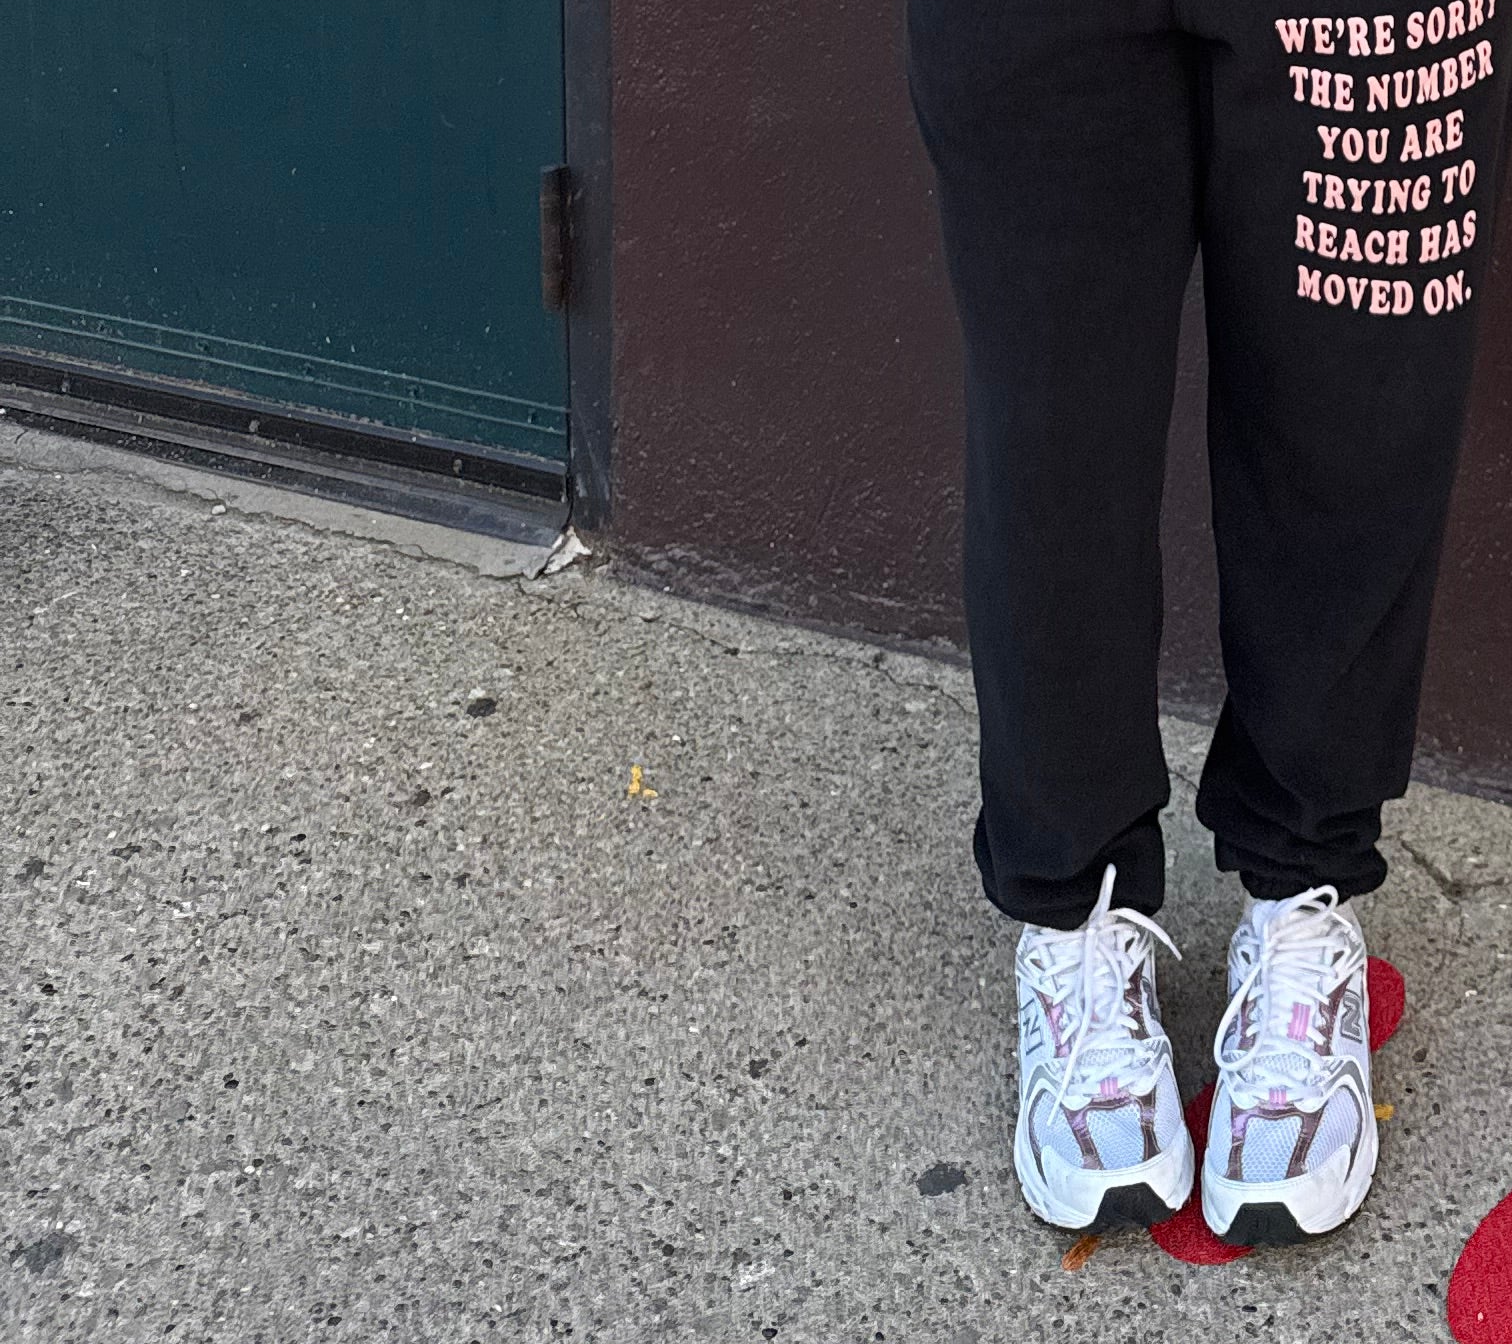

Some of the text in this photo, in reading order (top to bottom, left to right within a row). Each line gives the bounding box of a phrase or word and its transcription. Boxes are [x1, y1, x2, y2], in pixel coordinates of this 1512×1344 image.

[1275, 14, 1396, 56] WE'RE
[1289, 39, 1493, 112] THE NUMBER
[1317, 109, 1464, 164] YOU ARE
[1302, 159, 1476, 215] TRYING TO
[1294, 210, 1477, 265] REACH HAS
[1296, 265, 1472, 316] MOVED ON.
